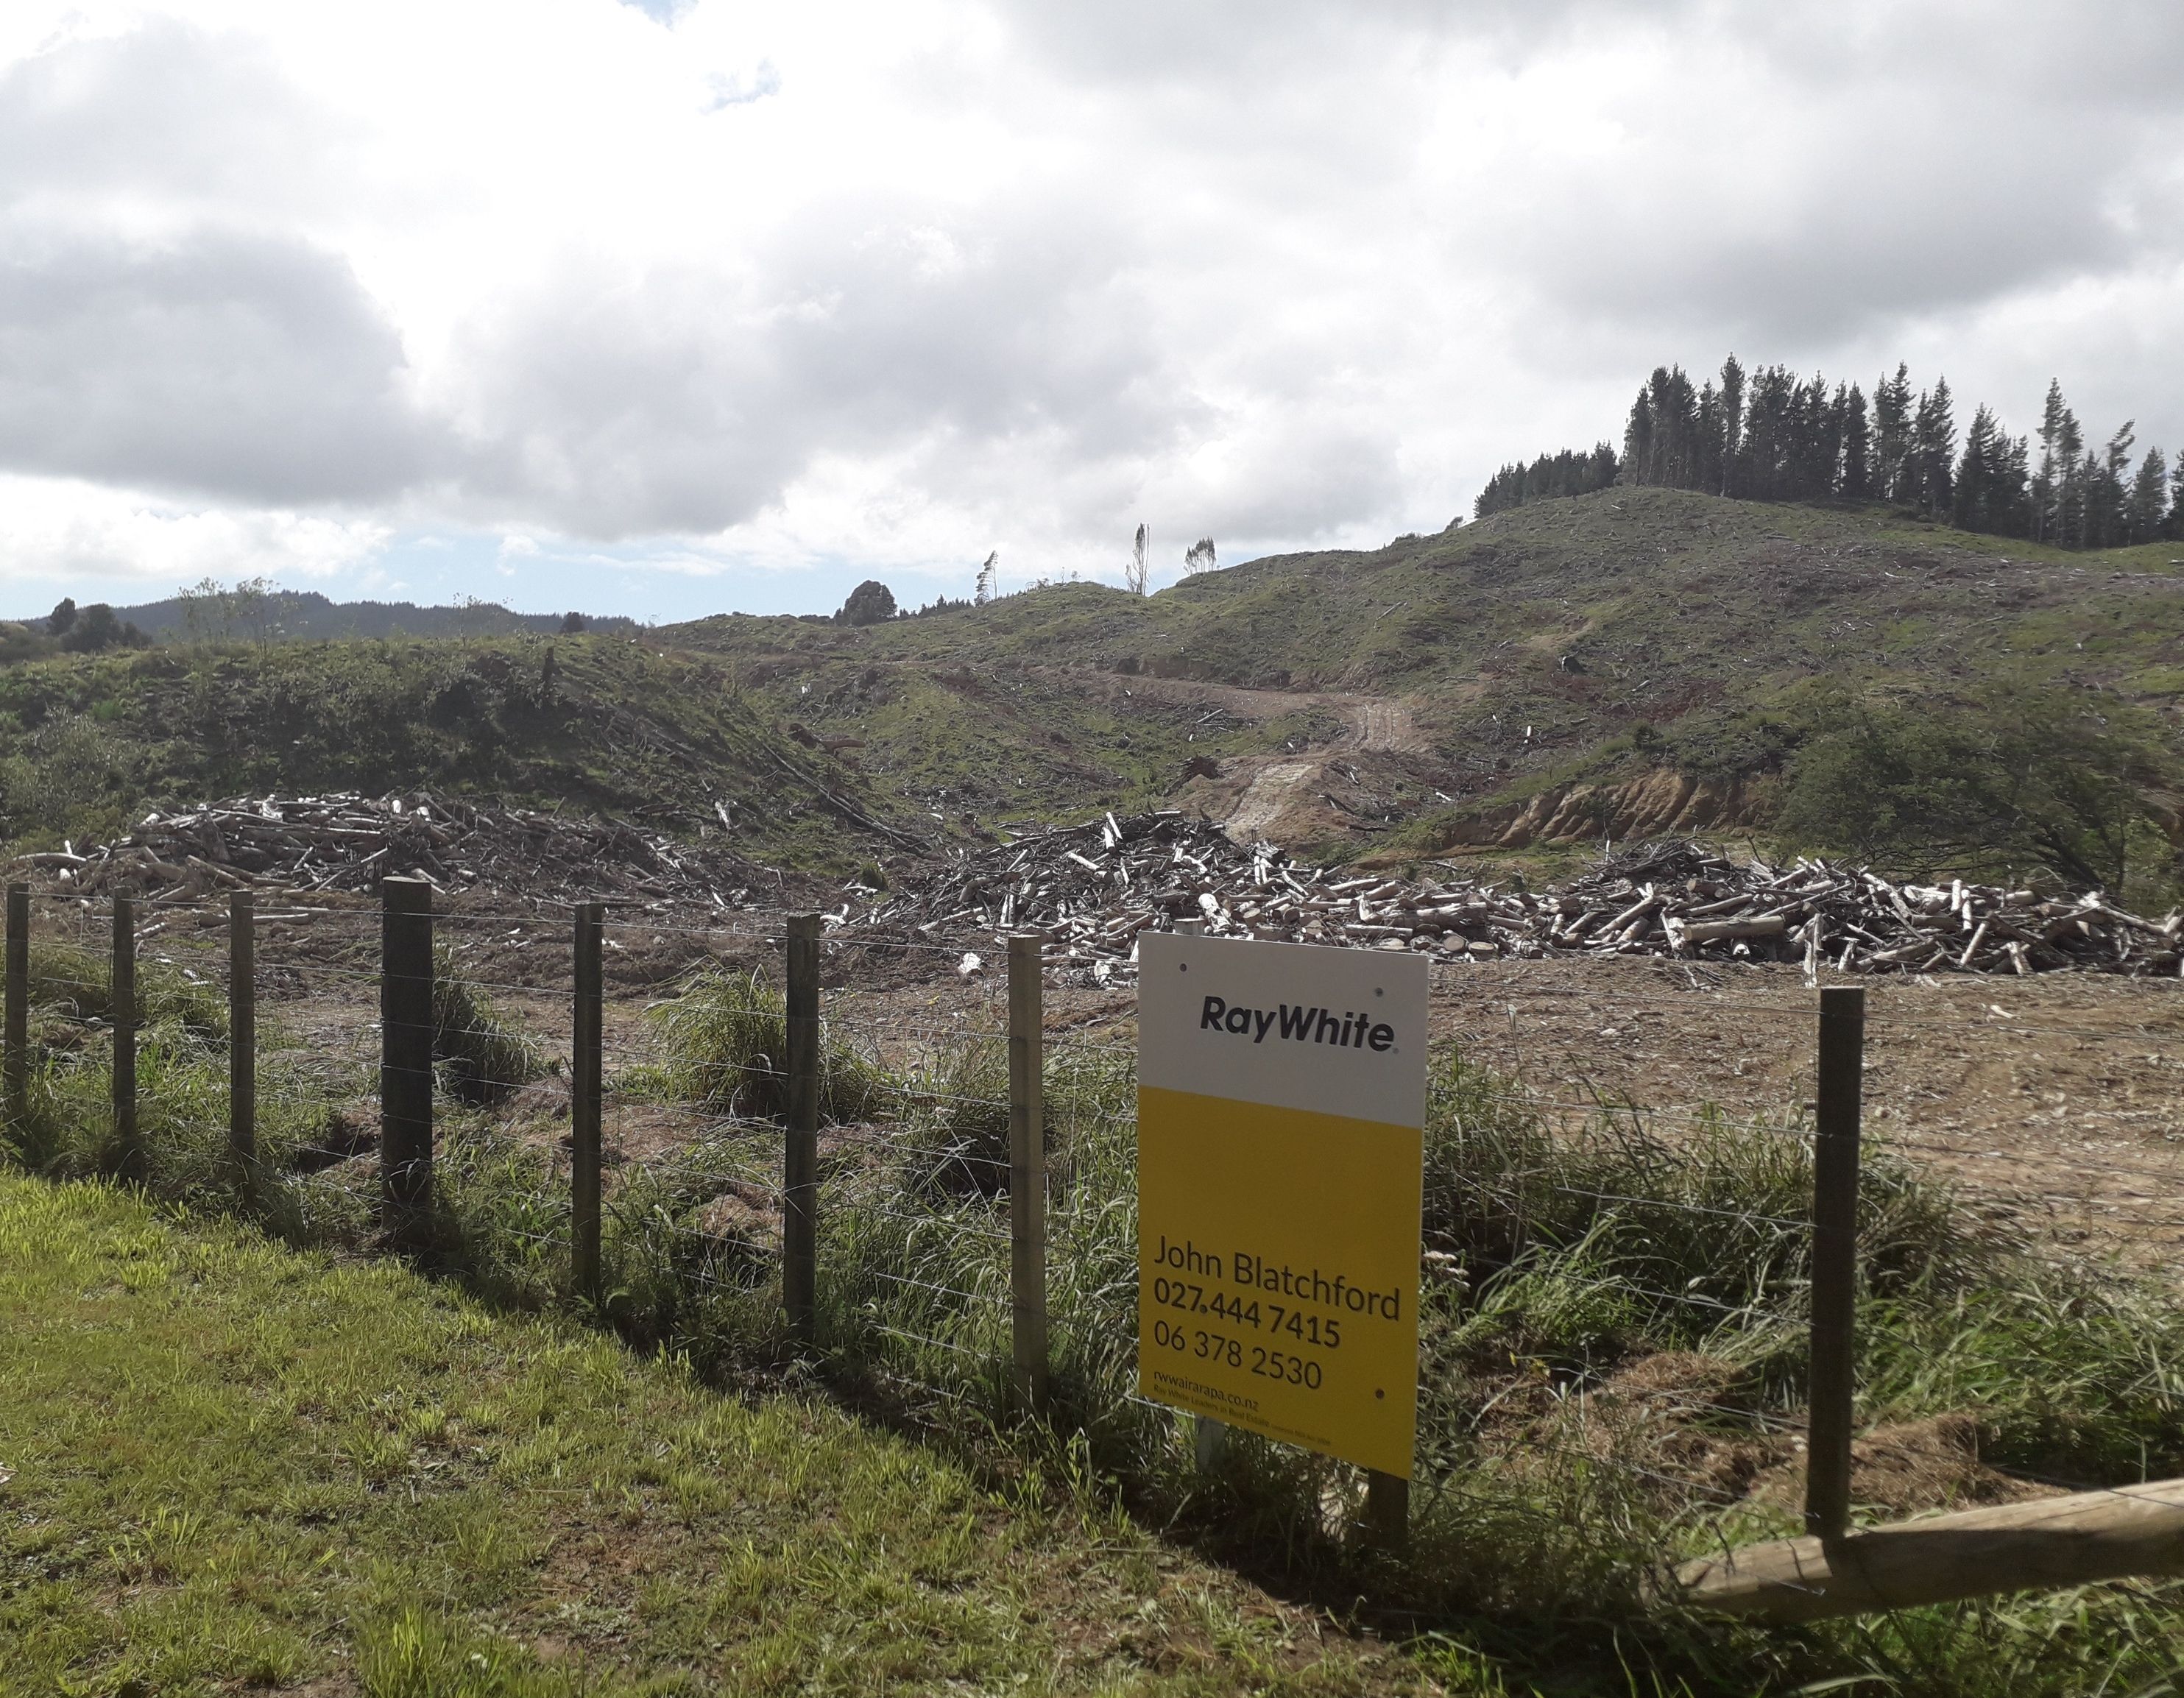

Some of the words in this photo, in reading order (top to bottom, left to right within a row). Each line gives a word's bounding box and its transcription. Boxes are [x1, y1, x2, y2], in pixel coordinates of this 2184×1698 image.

[1154, 1235, 1222, 1278] John
[1234, 1252, 1400, 1321] Blatchford
[1154, 1320, 1186, 1351] 06
[1194, 1331, 1242, 1368] 378
[1251, 1346, 1322, 1390] 2530
[1268, 1305, 1340, 1349] 7415
[1153, 1371, 1259, 1412] rwwairarapa.co.nz
